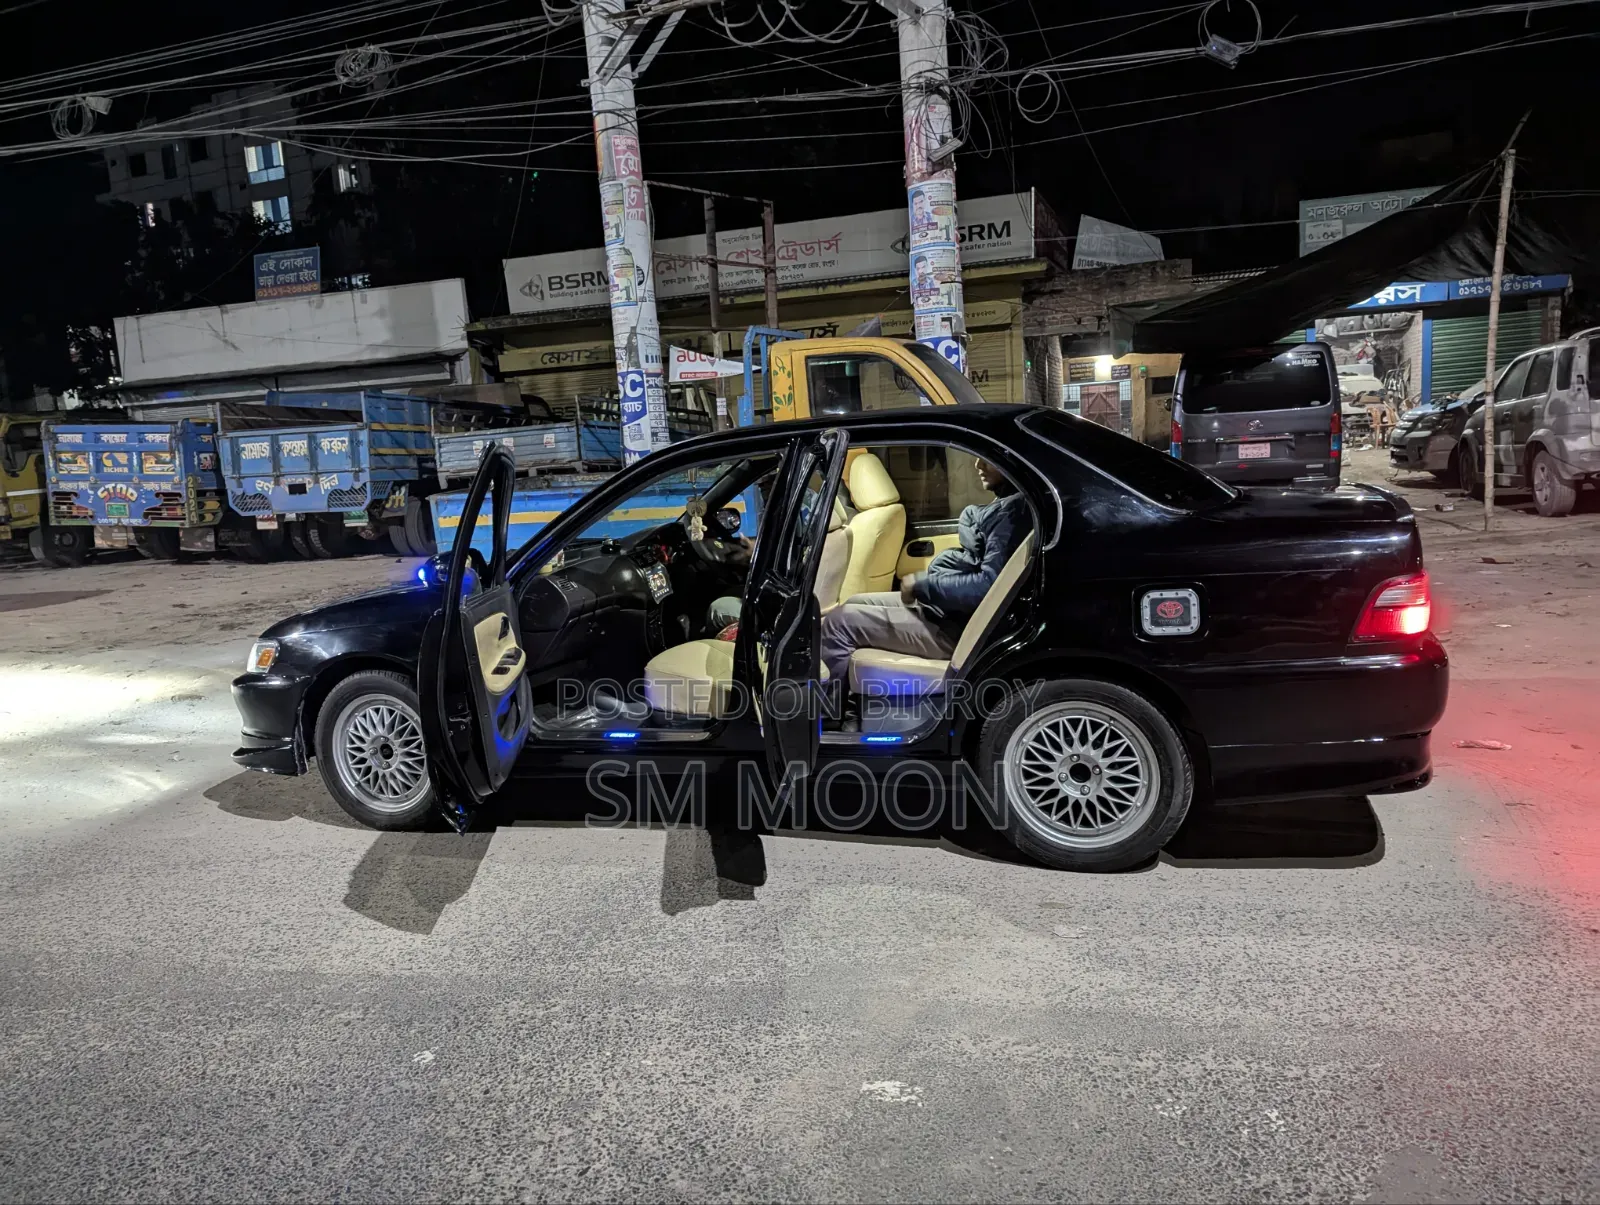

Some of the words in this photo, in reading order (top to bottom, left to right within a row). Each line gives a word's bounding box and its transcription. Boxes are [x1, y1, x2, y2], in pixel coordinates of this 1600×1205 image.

[957, 220, 1012, 243] SRM
[776, 231, 843, 261] ট্রেডার্স
[964, 243, 986, 252] safer
[987, 240, 1012, 249] nation
[260, 259, 277, 272] এই
[280, 256, 314, 270] দোকান
[549, 289, 574, 299] building
[579, 287, 597, 296] safer
[240, 442, 270, 460] নামাজ
[321, 437, 348, 455] করুন
[103, 466, 129, 474] EICHER
[97, 483, 138, 502] STOP
[320, 473, 339, 495] দিন
[187, 476, 199, 524] 2024
